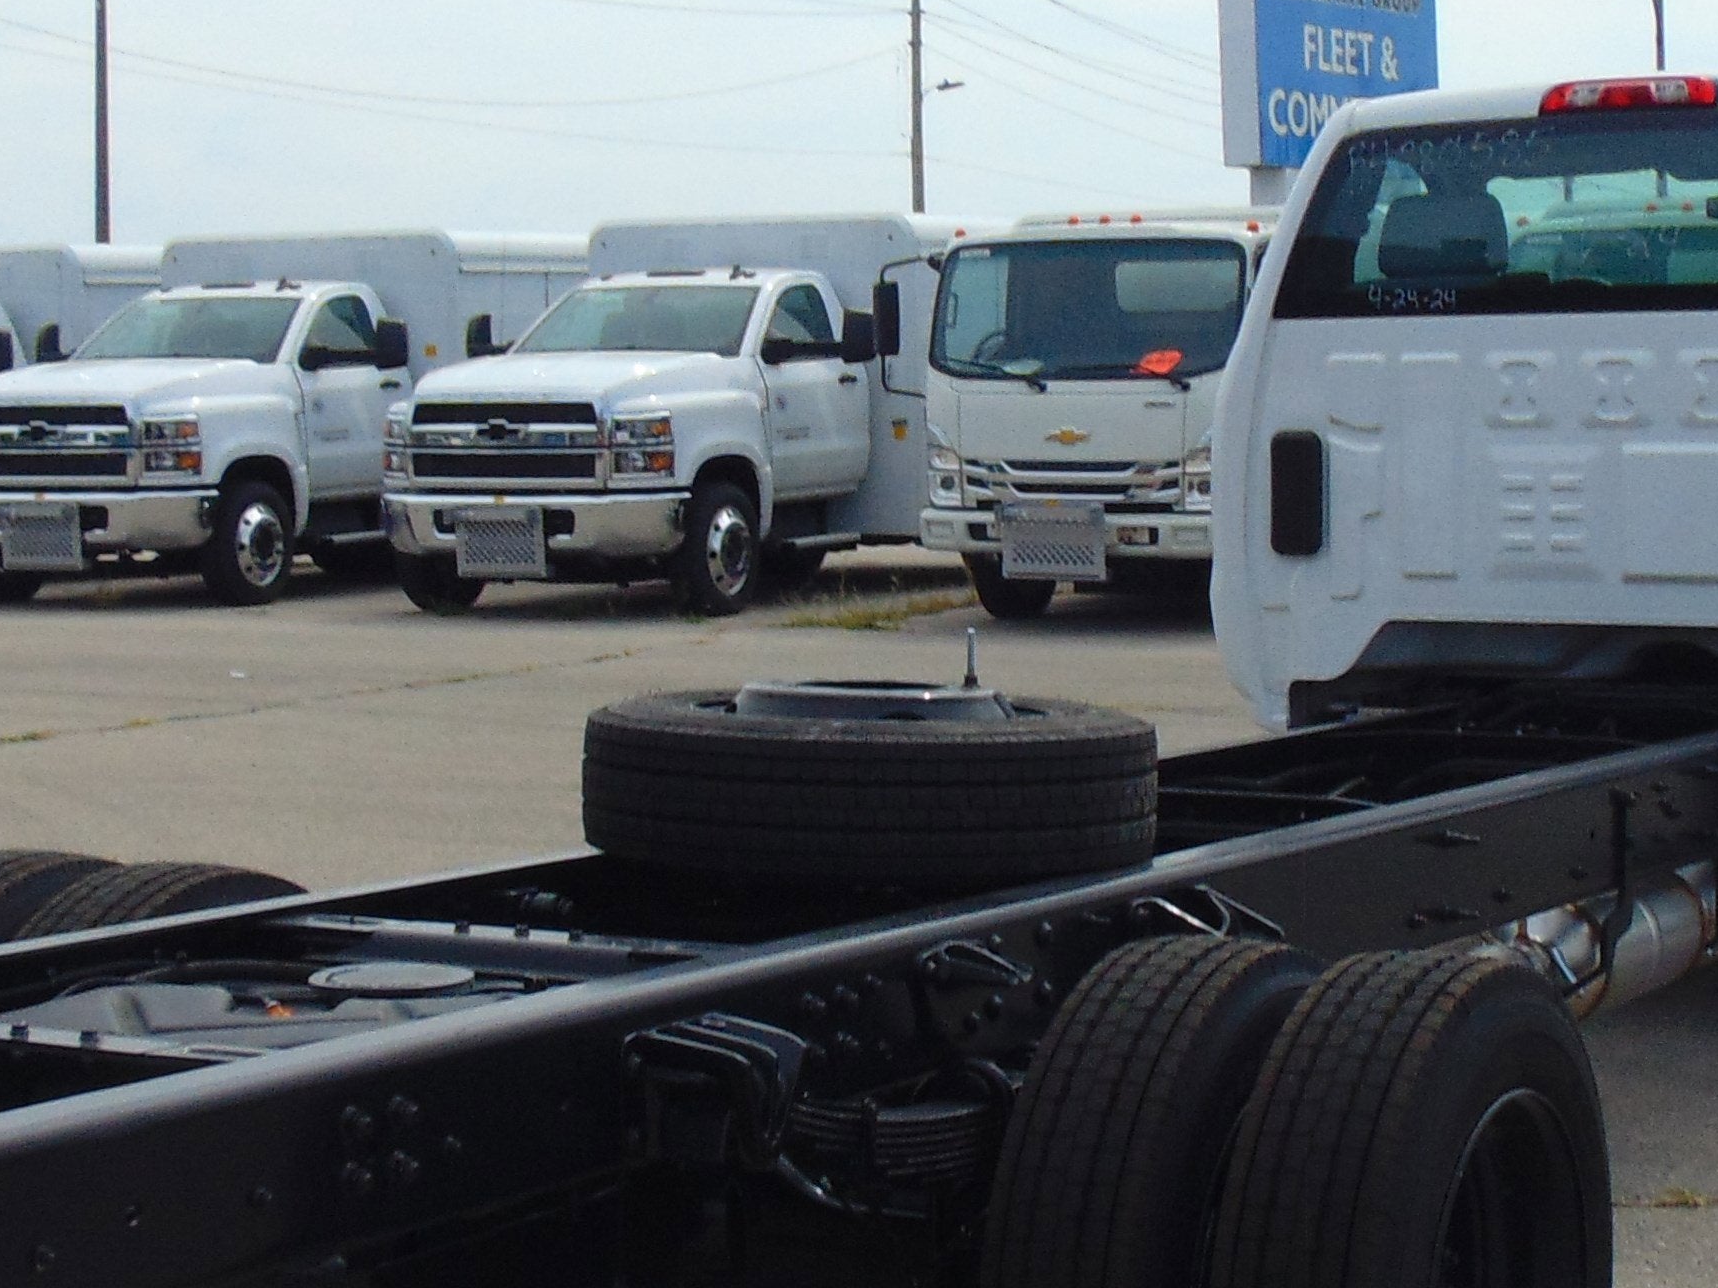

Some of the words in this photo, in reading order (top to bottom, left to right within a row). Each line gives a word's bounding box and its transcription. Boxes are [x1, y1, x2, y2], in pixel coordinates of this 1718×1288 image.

[1303, 23, 1375, 76] FLEET
[1380, 35, 1399, 81] &
[1368, 283, 1456, 311] 4-24-24
